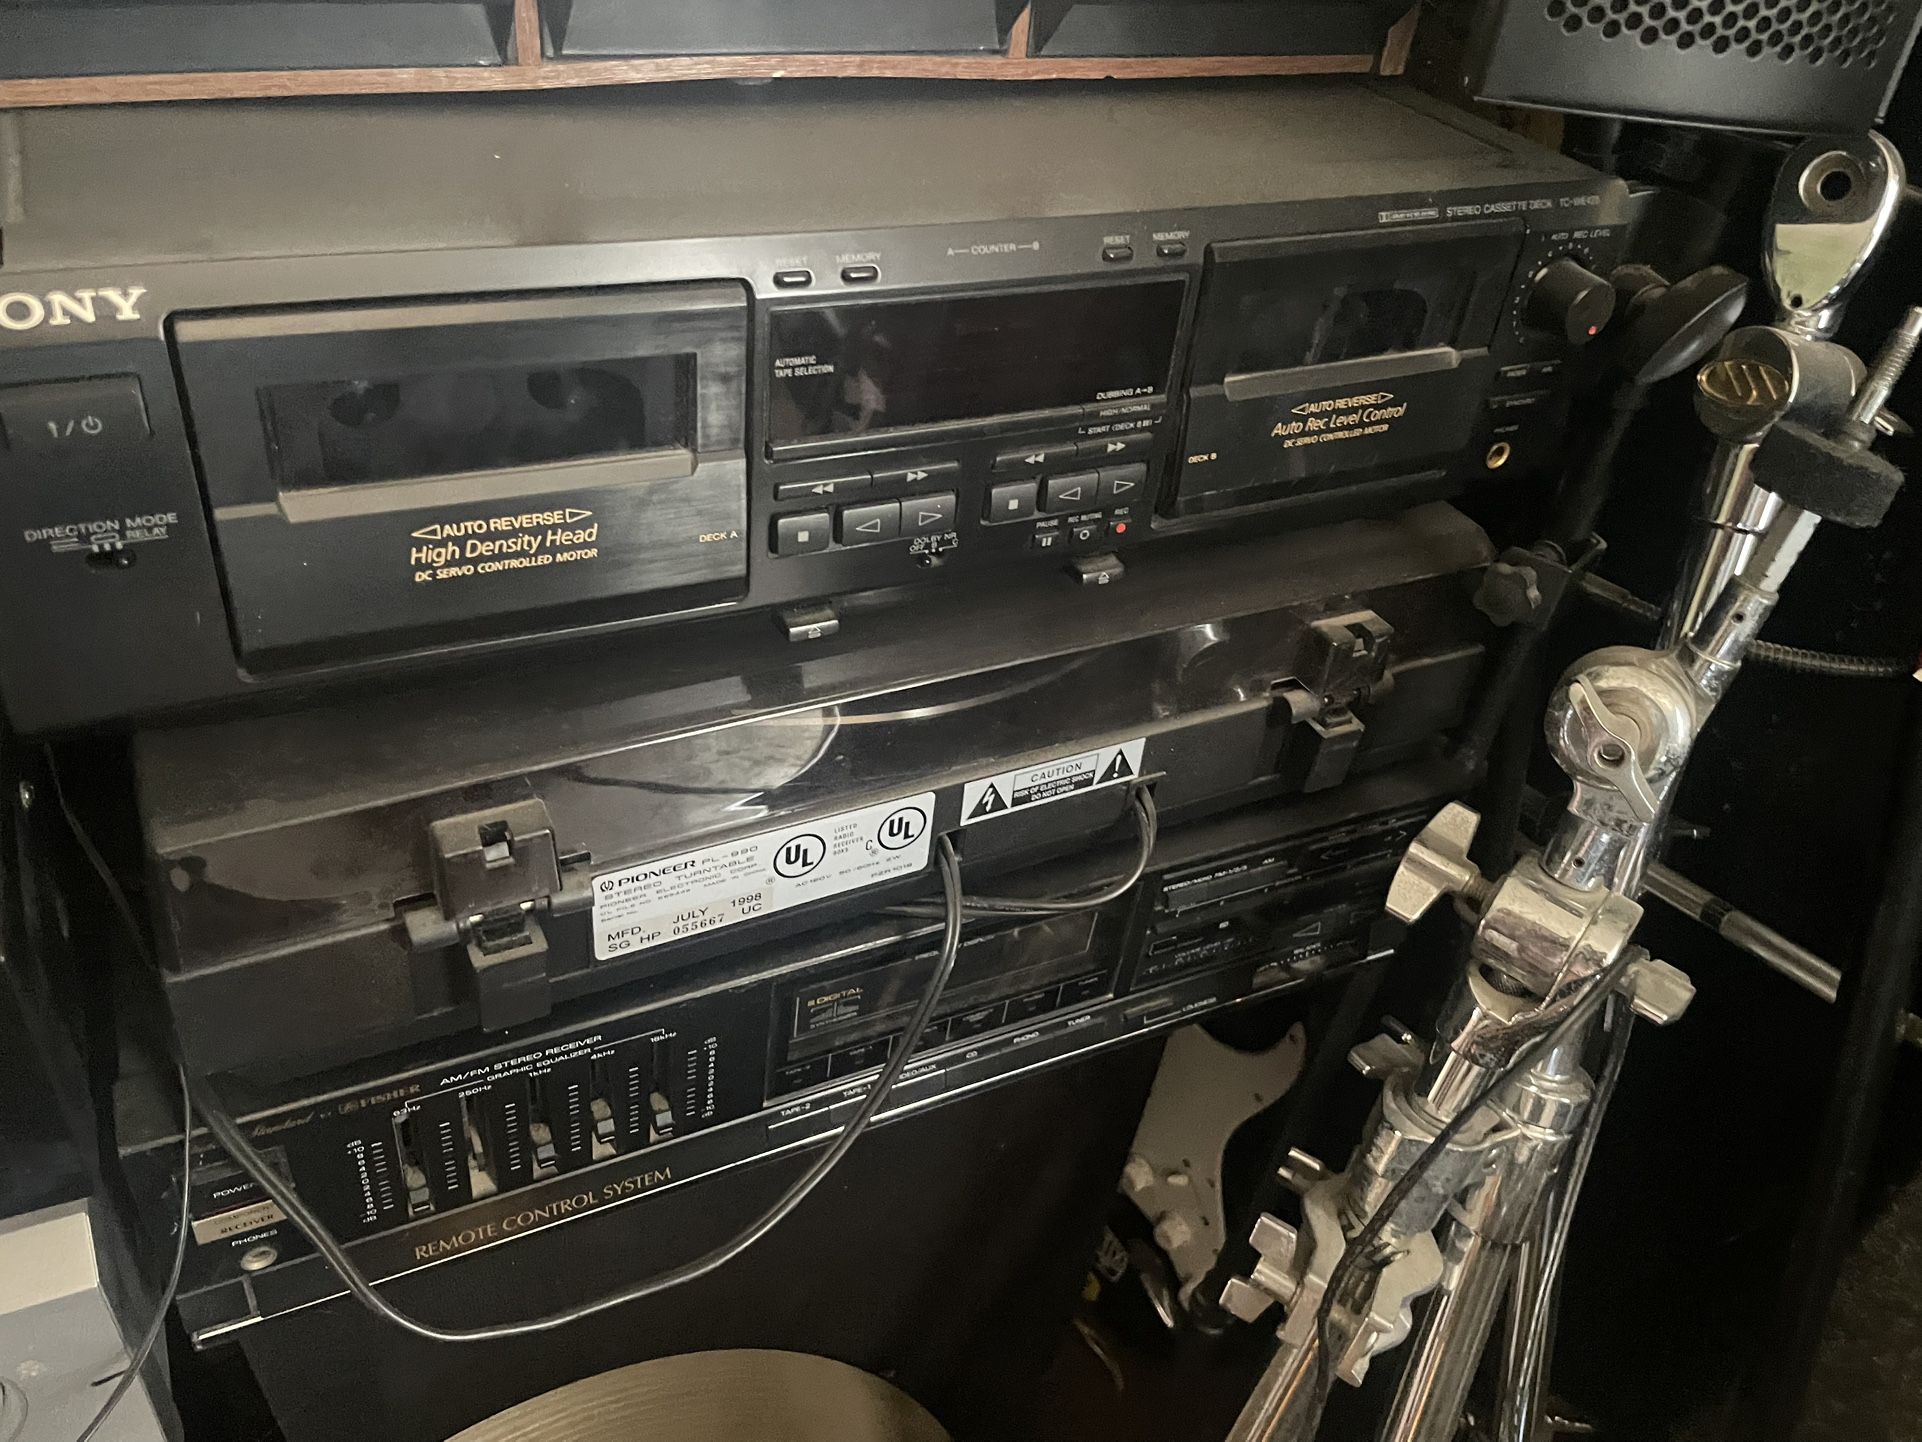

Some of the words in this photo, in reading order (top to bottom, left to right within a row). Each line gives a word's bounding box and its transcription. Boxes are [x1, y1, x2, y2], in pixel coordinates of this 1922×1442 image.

[1446, 205, 1481, 217] STEREO
[1483, 201, 1528, 213] CASSETTE
[1529, 199, 1552, 210] DECK
[1152, 230, 1190, 241] MEMORY
[836, 252, 881, 264] MEMORY
[971, 243, 1016, 255] COUNTER
[0, 286, 147, 330] ONY
[774, 355, 817, 367] AUTOMATIC
[774, 368, 793, 378] TAPE
[794, 364, 834, 376] SELECTION
[1096, 388, 1133, 400] DUBBING
[1307, 399, 1334, 413] AUTO
[1335, 393, 1379, 410] REVERSE
[1088, 425, 1110, 435] START
[1270, 421, 1303, 437] Auto
[1305, 416, 1327, 431] Rec
[1329, 410, 1361, 427] Level
[1363, 402, 1407, 422] Control
[1294, 434, 1318, 446] SERVO
[1319, 428, 1362, 443] CONTROLLED
[1363, 423, 1390, 436] MOTOR
[1187, 454, 1208, 464] DECK
[24, 519, 120, 543] DIRECTION
[125, 512, 178, 529] MODE
[126, 526, 168, 538] RELAY
[442, 520, 487, 537] AUTO
[490, 510, 565, 533] REVERSE
[410, 541, 460, 567] High
[465, 532, 542, 559] Density
[545, 524, 598, 547] Head
[699, 531, 727, 543] DECK
[729, 530, 738, 539] A
[415, 569, 432, 582] DC
[436, 565, 474, 580] SERVO
[477, 553, 553, 575] CONTROLLED
[555, 548, 598, 564] MOTOR
[1031, 762, 1082, 783] CAUTION
[1013, 788, 1030, 799] RISK
[1030, 785, 1040, 794] OF
[1039, 778, 1071, 792] ELECTRIC
[1071, 771, 1094, 783] SHOCK
[1031, 793, 1042, 801] DO
[1042, 788, 1056, 798] NOT
[1056, 784, 1075, 794] OPEN
[888, 816, 915, 840] UL
[785, 844, 814, 868] UL
[605, 880, 662, 900] STEREO
[675, 855, 755, 881] TURNTABLE
[618, 860, 696, 887] PIONEER
[600, 893, 646, 910] PIONEER
[656, 873, 721, 894] ELECTRONIC
[607, 926, 645, 942] MFD.
[673, 907, 709, 924] JULY
[731, 892, 762, 908] 1998
[608, 940, 630, 952] SG
[640, 931, 661, 944] HP
[673, 913, 726, 936] 055667
[741, 903, 762, 915] UC
[816, 987, 864, 1005] DIGITAL
[439, 1066, 490, 1086] AM/FM
[493, 1051, 543, 1071] STEREO
[545, 1035, 603, 1056] RECEIVER
[487, 1064, 534, 1082] GRAPHIC
[536, 1047, 592, 1067] EQUALIZER
[221, 1214, 274, 1234] RECEIVER
[414, 1224, 497, 1260] REMOTE
[502, 1191, 599, 1231] CONTROL
[602, 1166, 672, 1200] SYSTEM
[231, 1229, 278, 1247] PHONES
